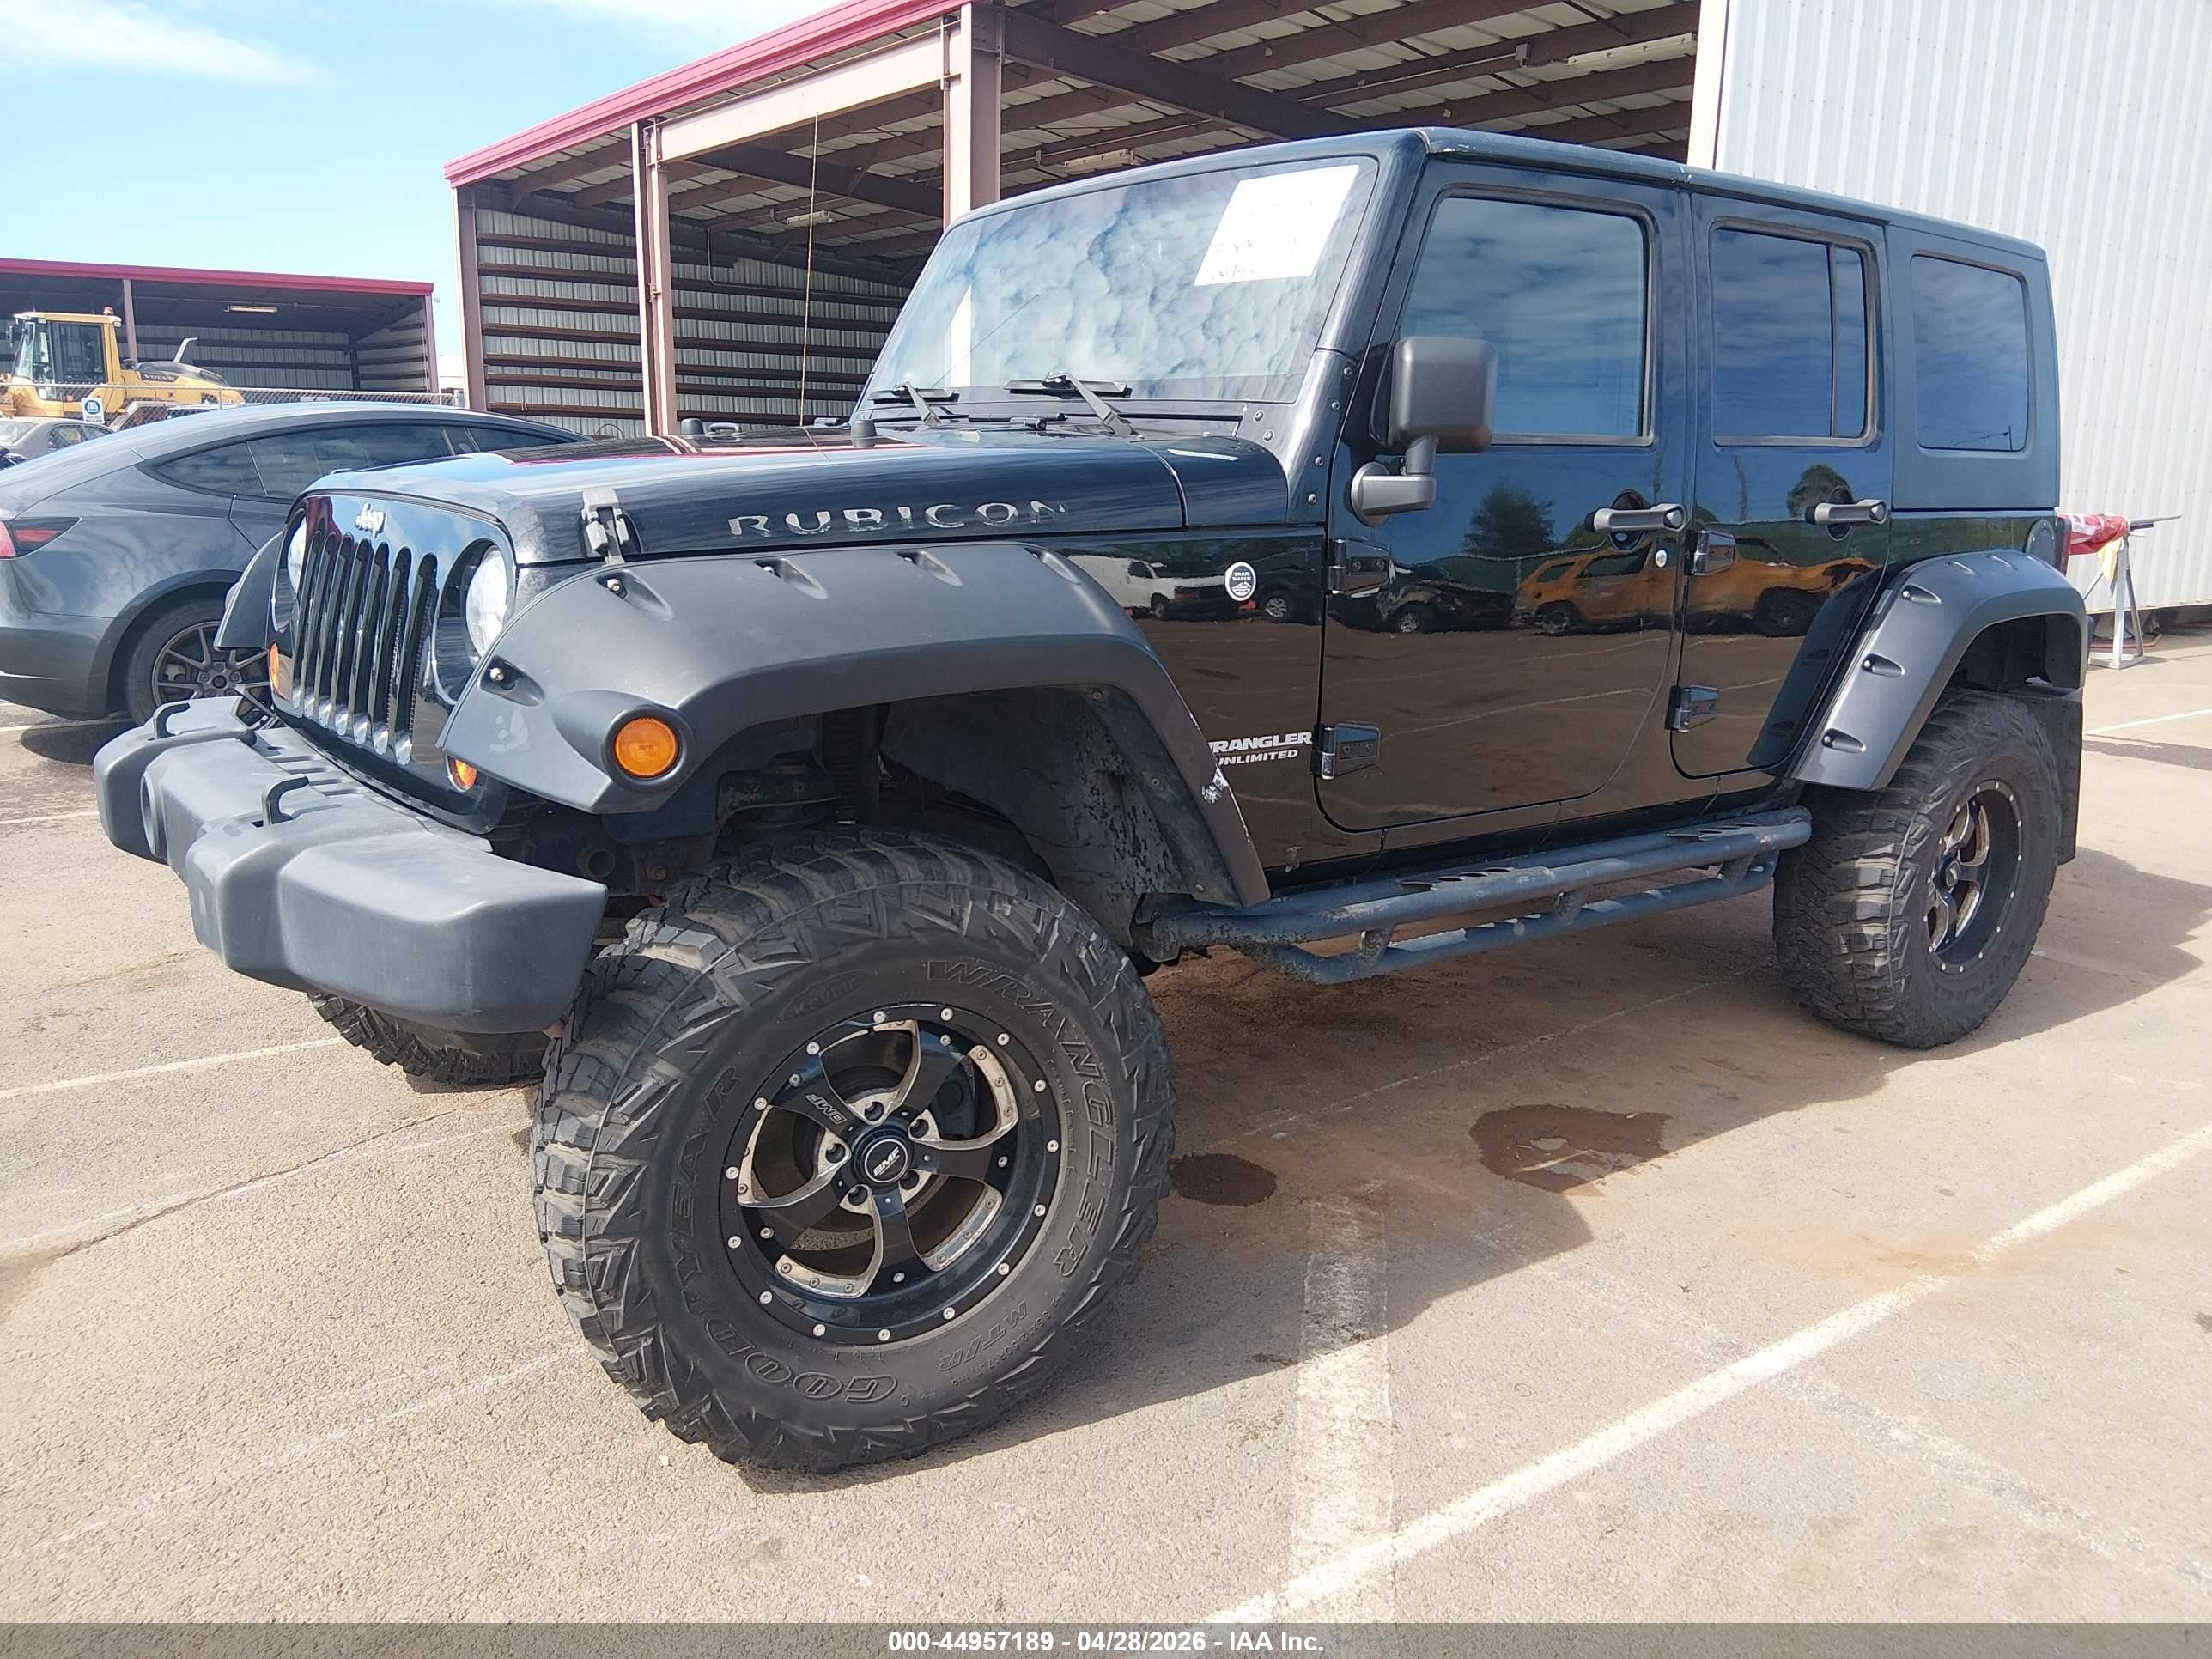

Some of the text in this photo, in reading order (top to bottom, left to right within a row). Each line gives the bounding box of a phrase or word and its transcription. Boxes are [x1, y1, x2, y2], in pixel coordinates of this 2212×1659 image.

[356, 502, 386, 538] Jeep
[727, 501, 1066, 538] RUBICON
[805, 1093, 848, 1126] BMF
[927, 960, 1114, 1278] WRANGLER
[872, 1146, 900, 1176] BMF
[669, 1066, 898, 1402] GOODYEAR
